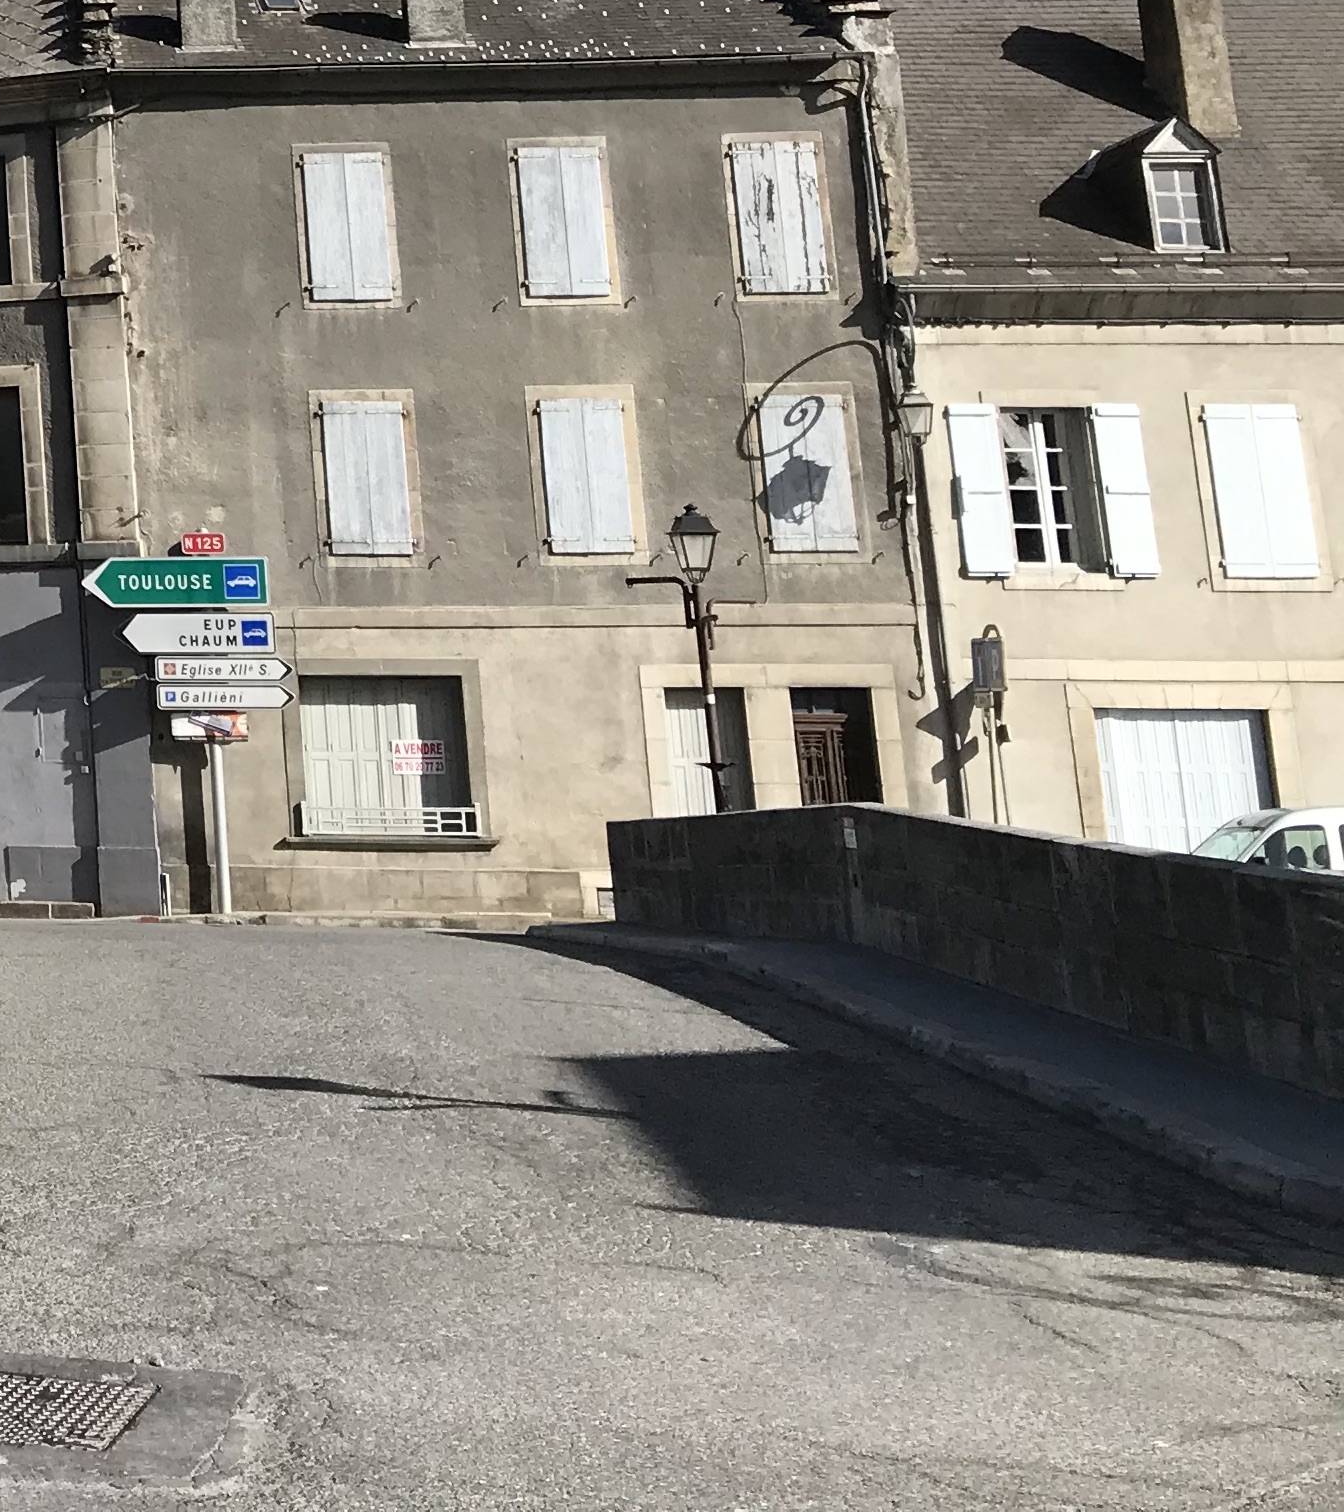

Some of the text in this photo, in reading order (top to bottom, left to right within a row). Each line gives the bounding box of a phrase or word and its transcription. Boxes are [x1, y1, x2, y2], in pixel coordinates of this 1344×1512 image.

[118, 574, 212, 591] TOULOUSE
[204, 619, 237, 631] EUP
[178, 635, 238, 647] CHAUM
[181, 663, 222, 679] Eglise
[394, 743, 442, 755] A VENDRE
